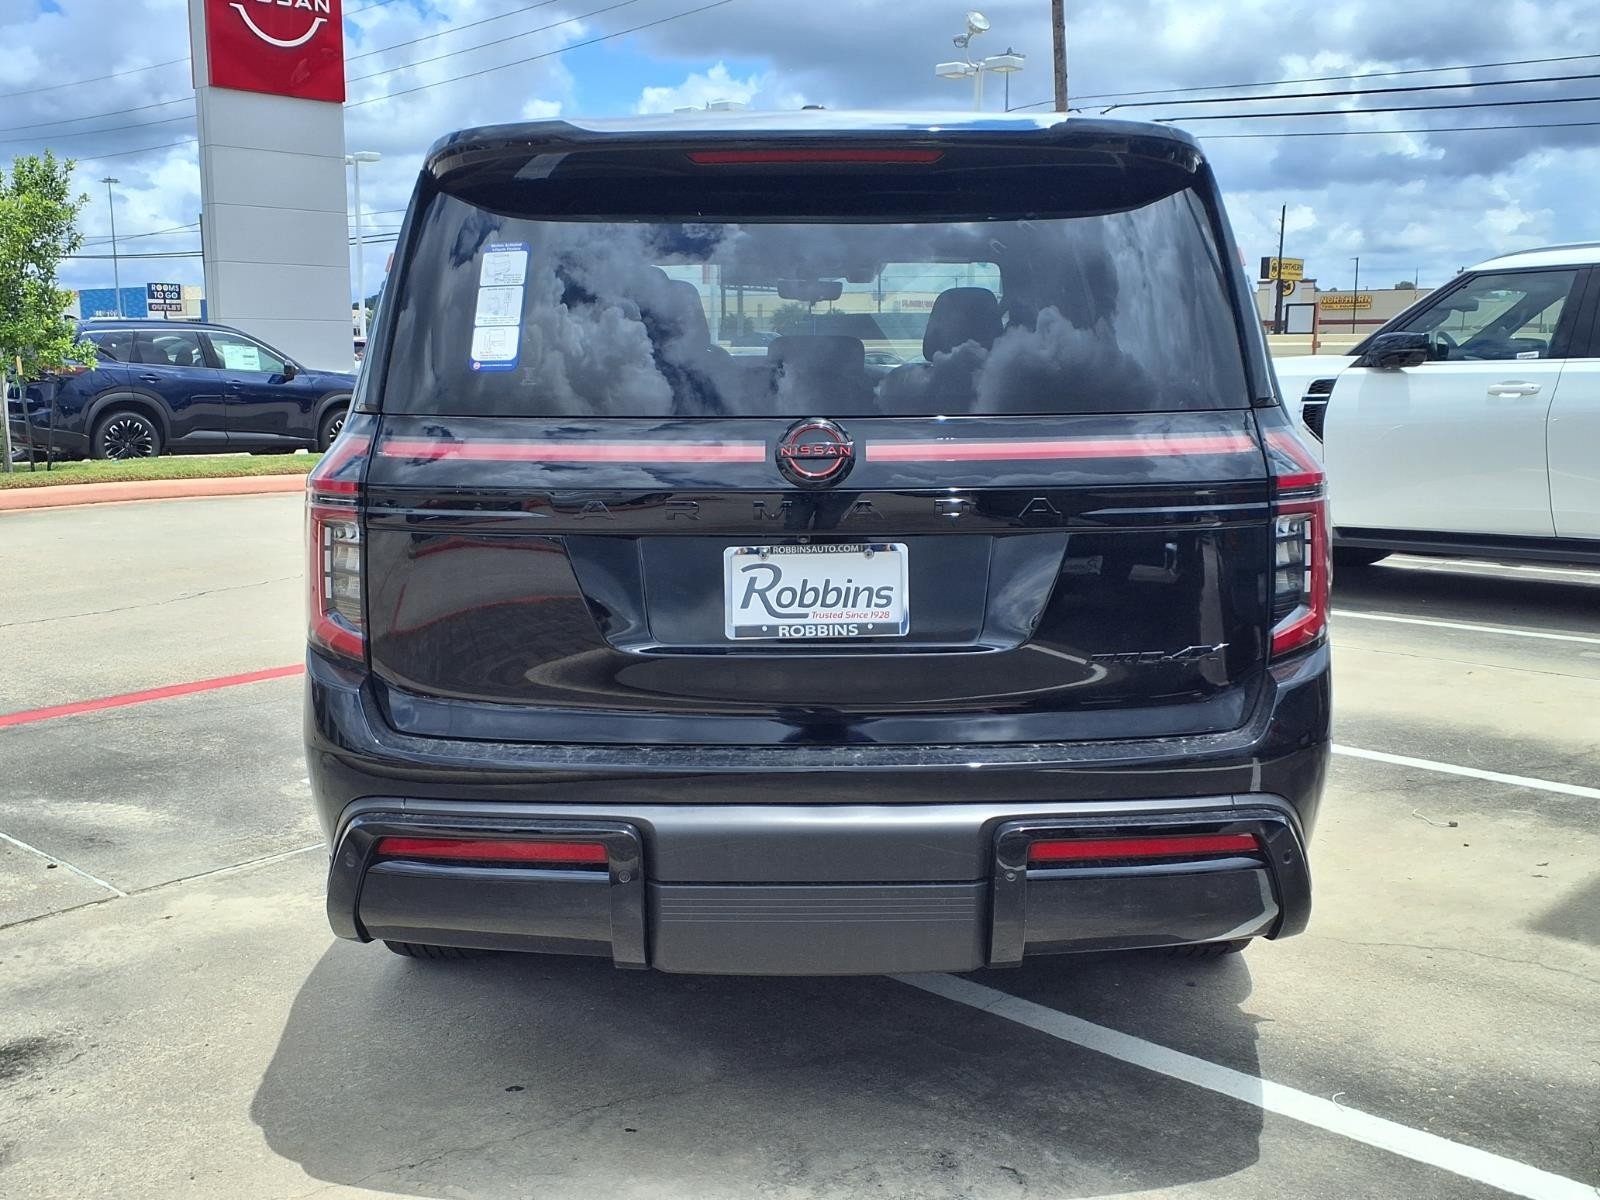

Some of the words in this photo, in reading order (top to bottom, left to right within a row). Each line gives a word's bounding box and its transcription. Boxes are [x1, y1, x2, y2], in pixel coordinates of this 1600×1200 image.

[151, 284, 179, 292] ROOMS
[153, 291, 164, 299] TO
[165, 291, 178, 299] GO
[780, 446, 852, 456] NISSAN
[573, 498, 1062, 520] ARMADA
[772, 545, 859, 554] ROBBINSAUTO.COM
[740, 563, 894, 619] Robbins
[812, 610, 844, 619] Trusted
[845, 610, 869, 619] Since
[870, 610, 890, 619] 1928
[778, 623, 859, 637] ROBBINS
